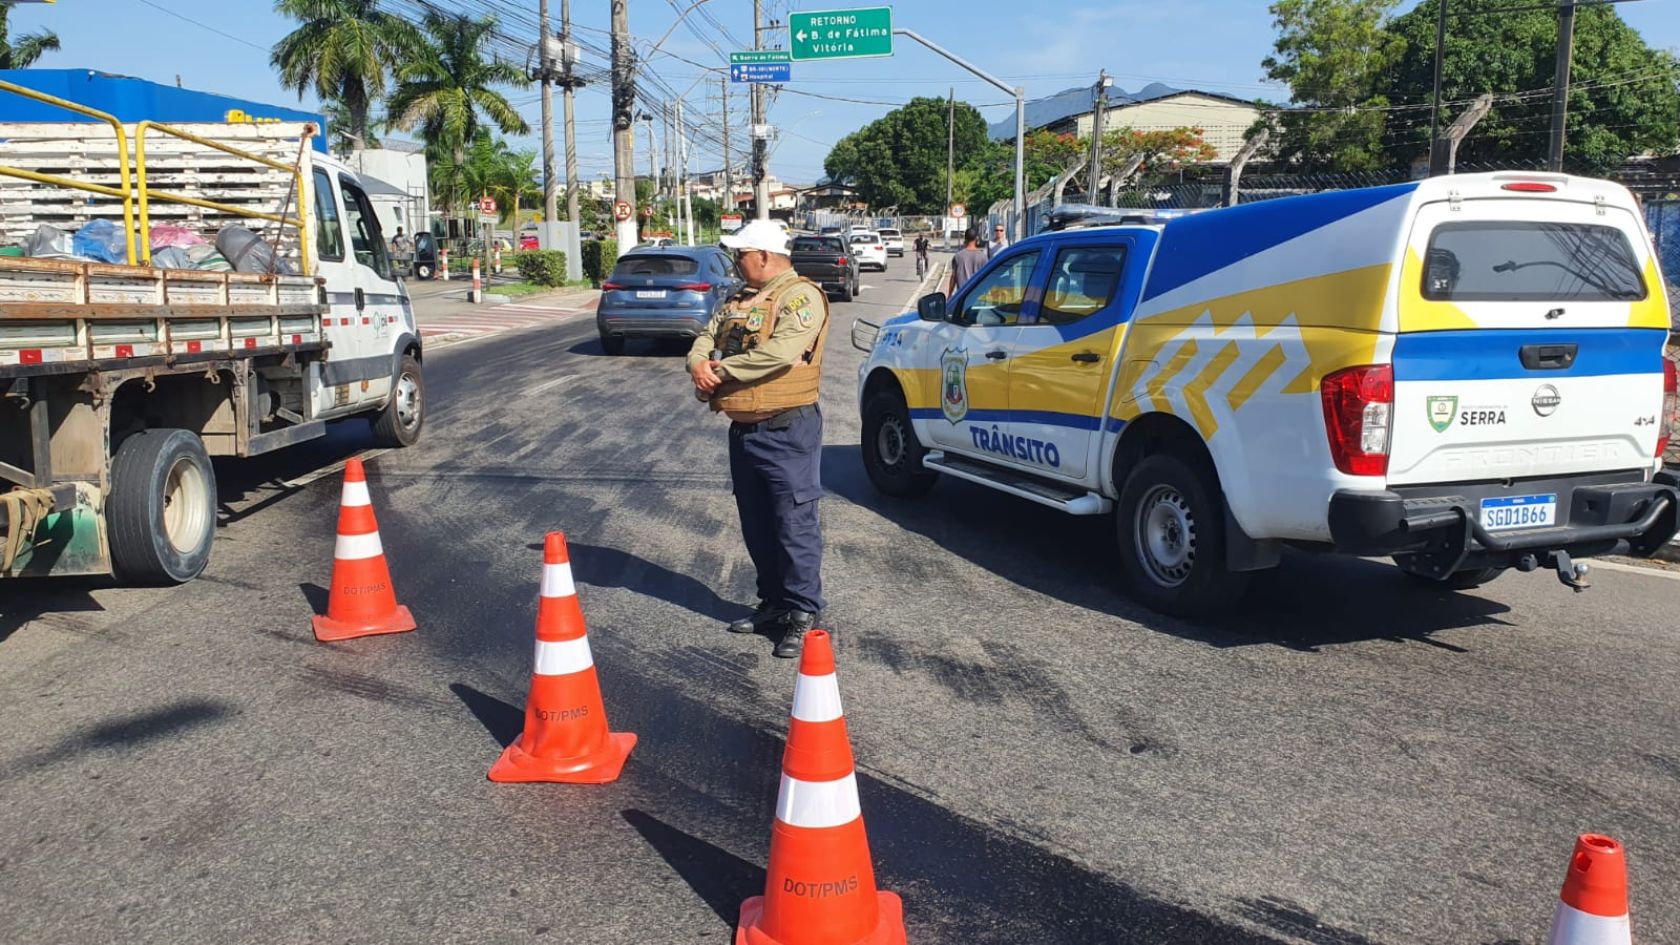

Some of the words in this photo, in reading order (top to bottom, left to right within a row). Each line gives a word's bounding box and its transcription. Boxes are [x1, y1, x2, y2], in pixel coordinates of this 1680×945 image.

[810, 15, 857, 26] RETORNO
[811, 30, 822, 40] B.
[827, 30, 840, 39] de
[846, 26, 887, 38] Fátima
[812, 42, 854, 53] Vitória
[1460, 411, 1506, 426] SERRA
[969, 424, 1060, 468] TRÂNSITO
[1487, 506, 1547, 527] SGD1B66
[535, 705, 589, 722] DOT/PMS
[783, 875, 858, 898] DOT/PMS
